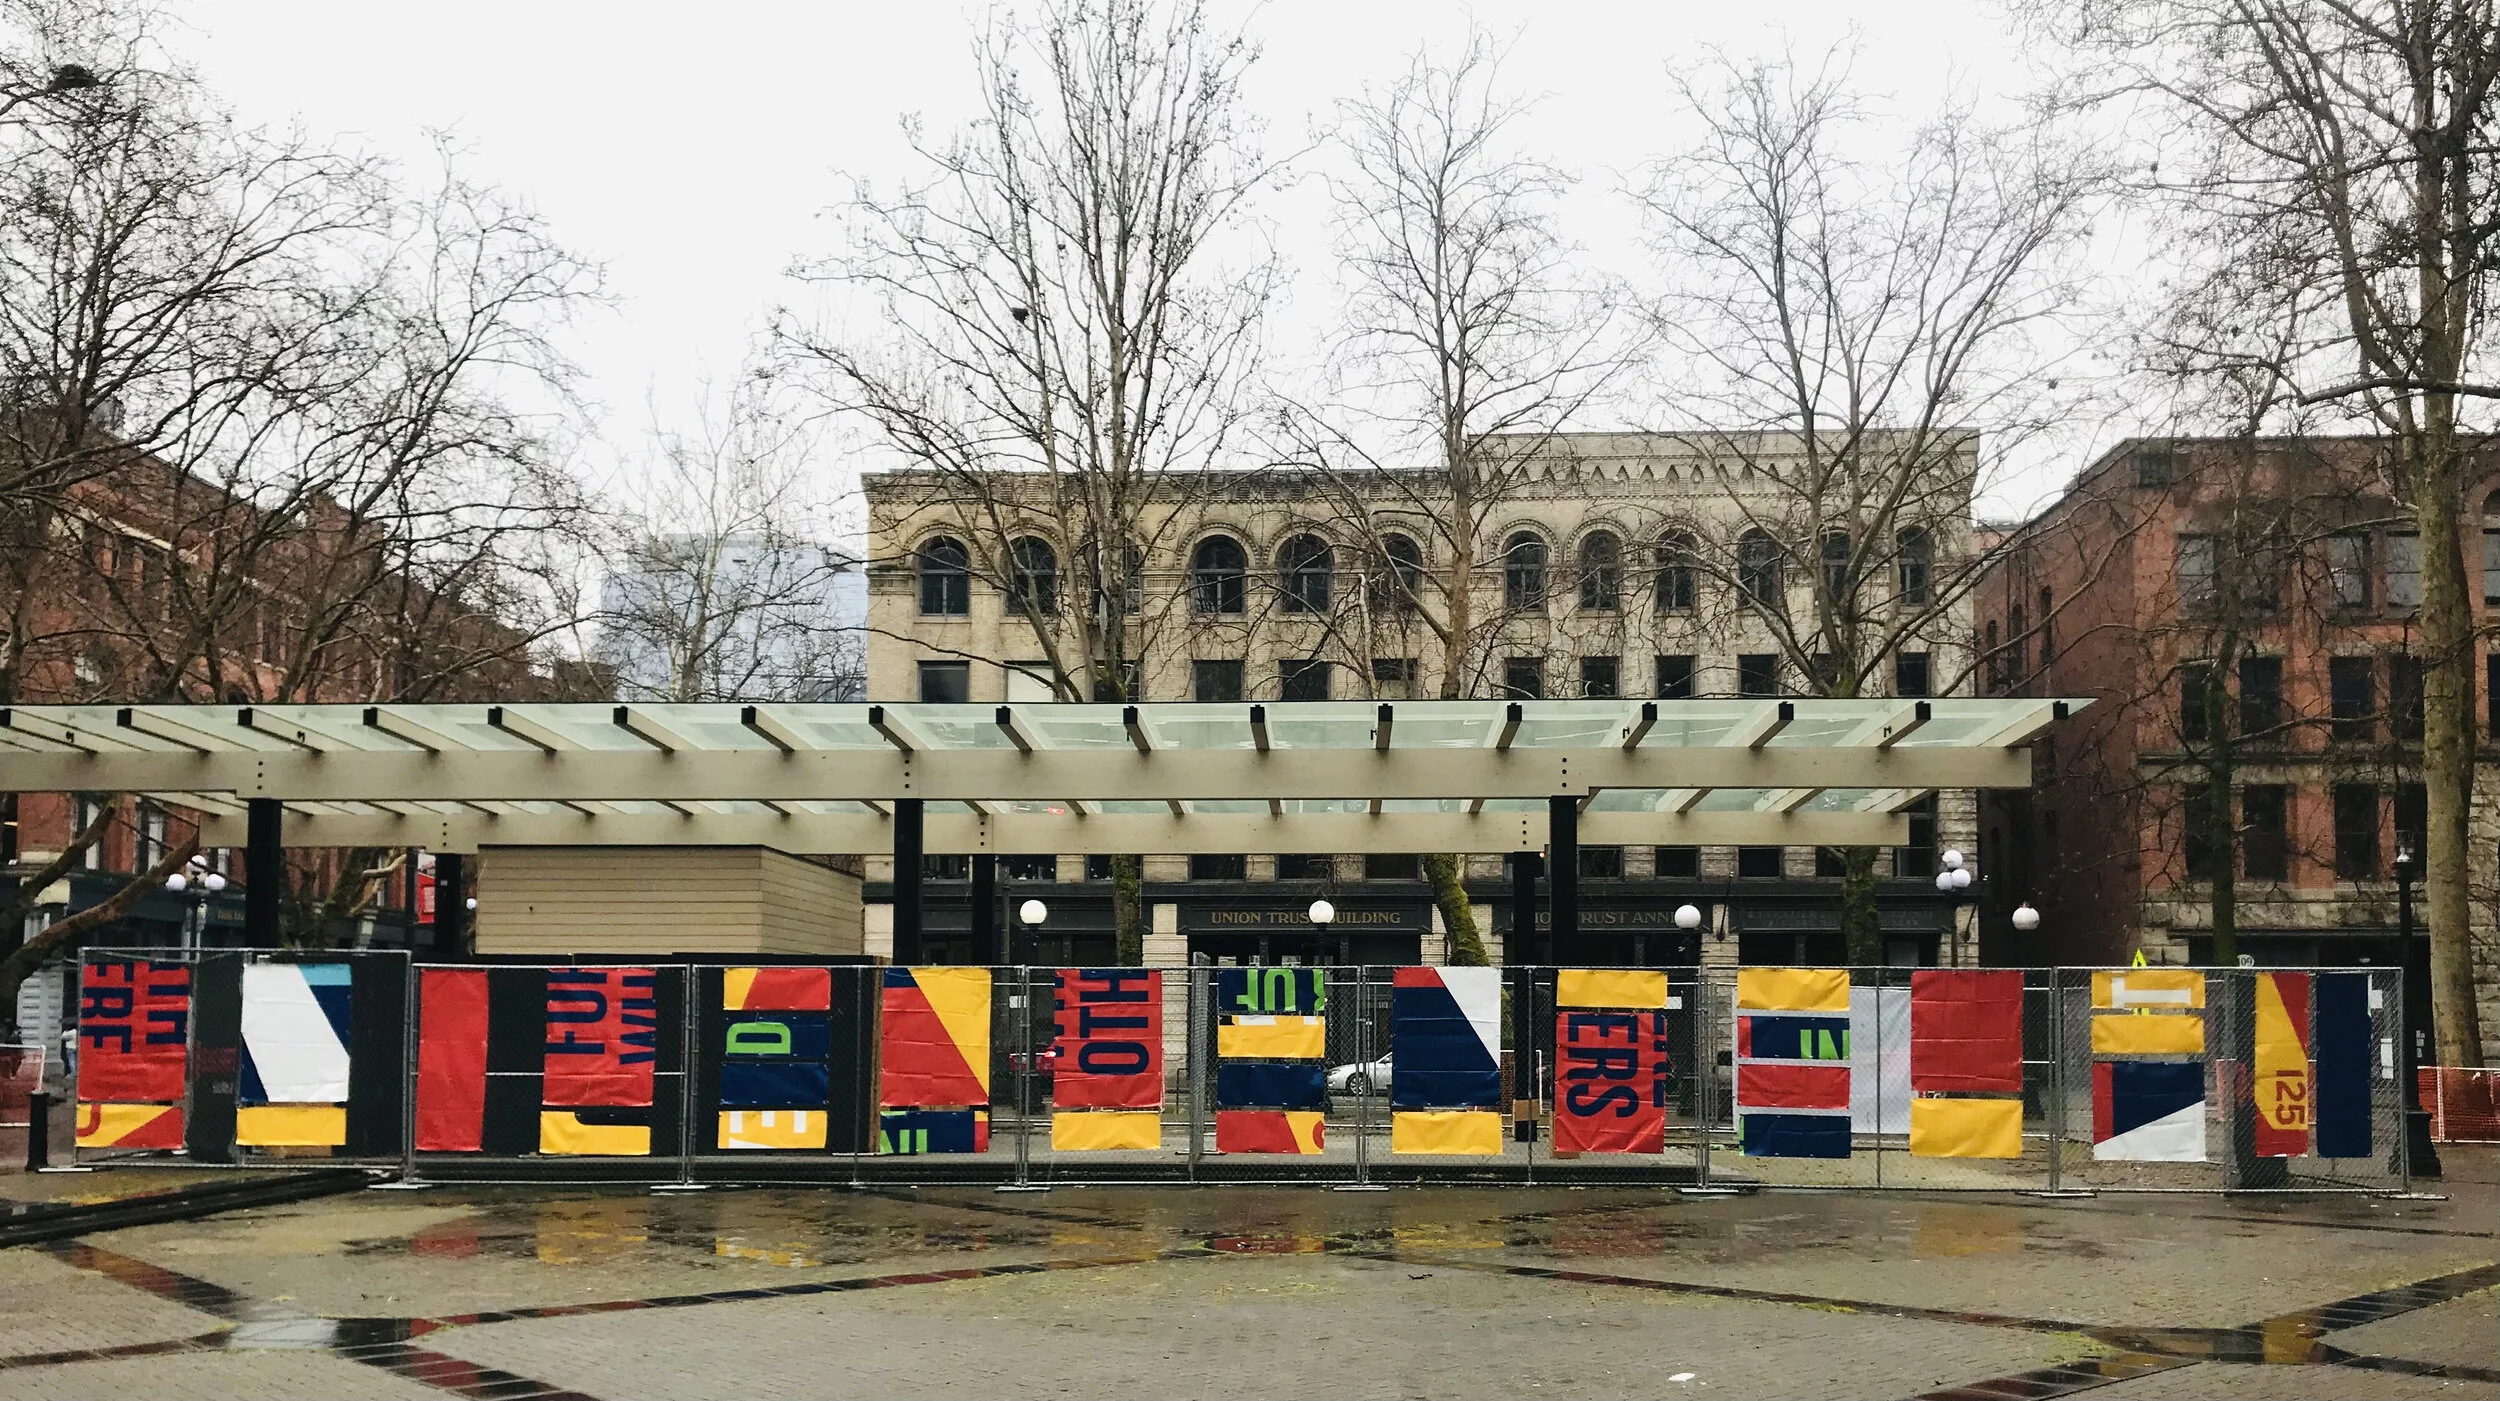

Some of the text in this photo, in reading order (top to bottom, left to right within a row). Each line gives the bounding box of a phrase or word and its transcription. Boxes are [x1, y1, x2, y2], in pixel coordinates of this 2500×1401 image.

[1211, 911, 1401, 924] UNION TRUS UILDING
[2275, 1069, 2306, 1126] 125
